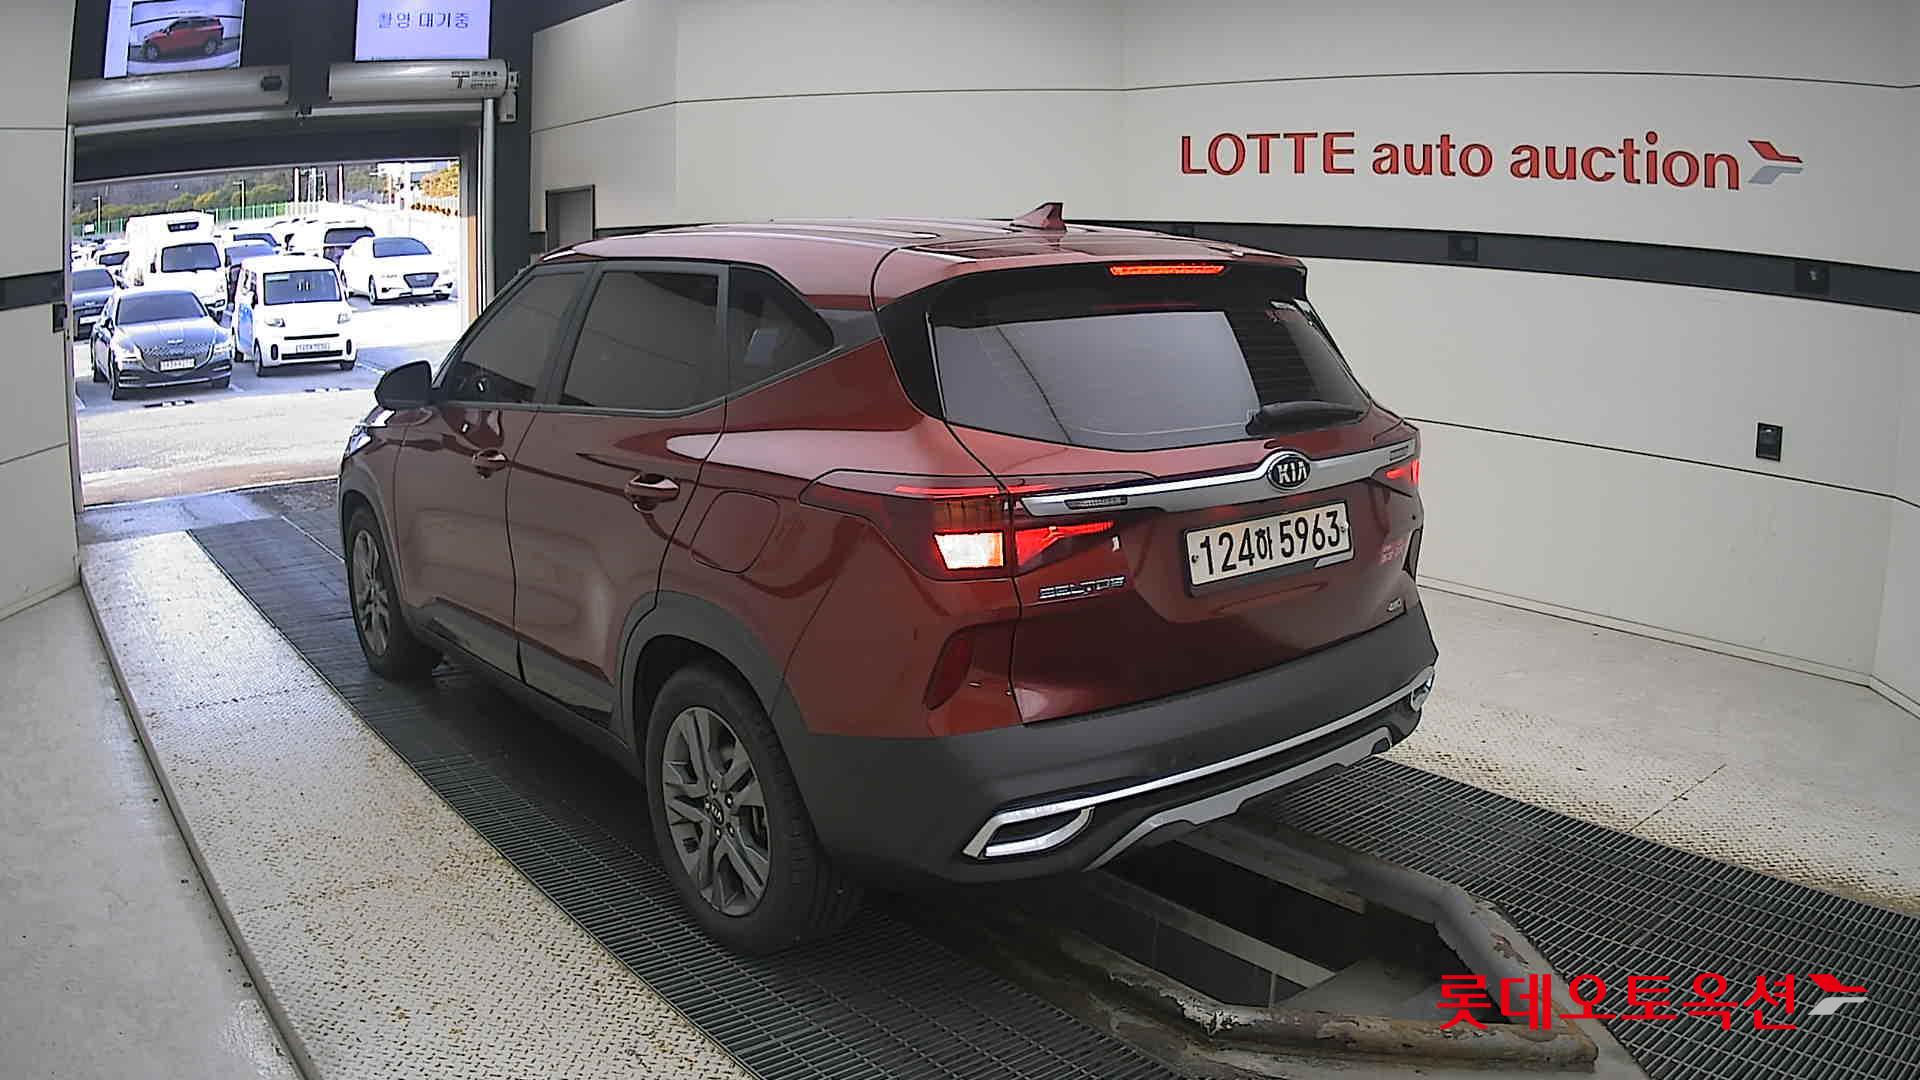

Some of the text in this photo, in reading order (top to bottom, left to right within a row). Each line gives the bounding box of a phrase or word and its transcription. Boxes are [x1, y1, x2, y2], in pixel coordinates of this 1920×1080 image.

[1181, 131, 1740, 190] LOTTE auto auction
[1276, 461, 1308, 484] KIA
[1200, 526, 1274, 575] 124하
[1279, 510, 1340, 558] 5963
